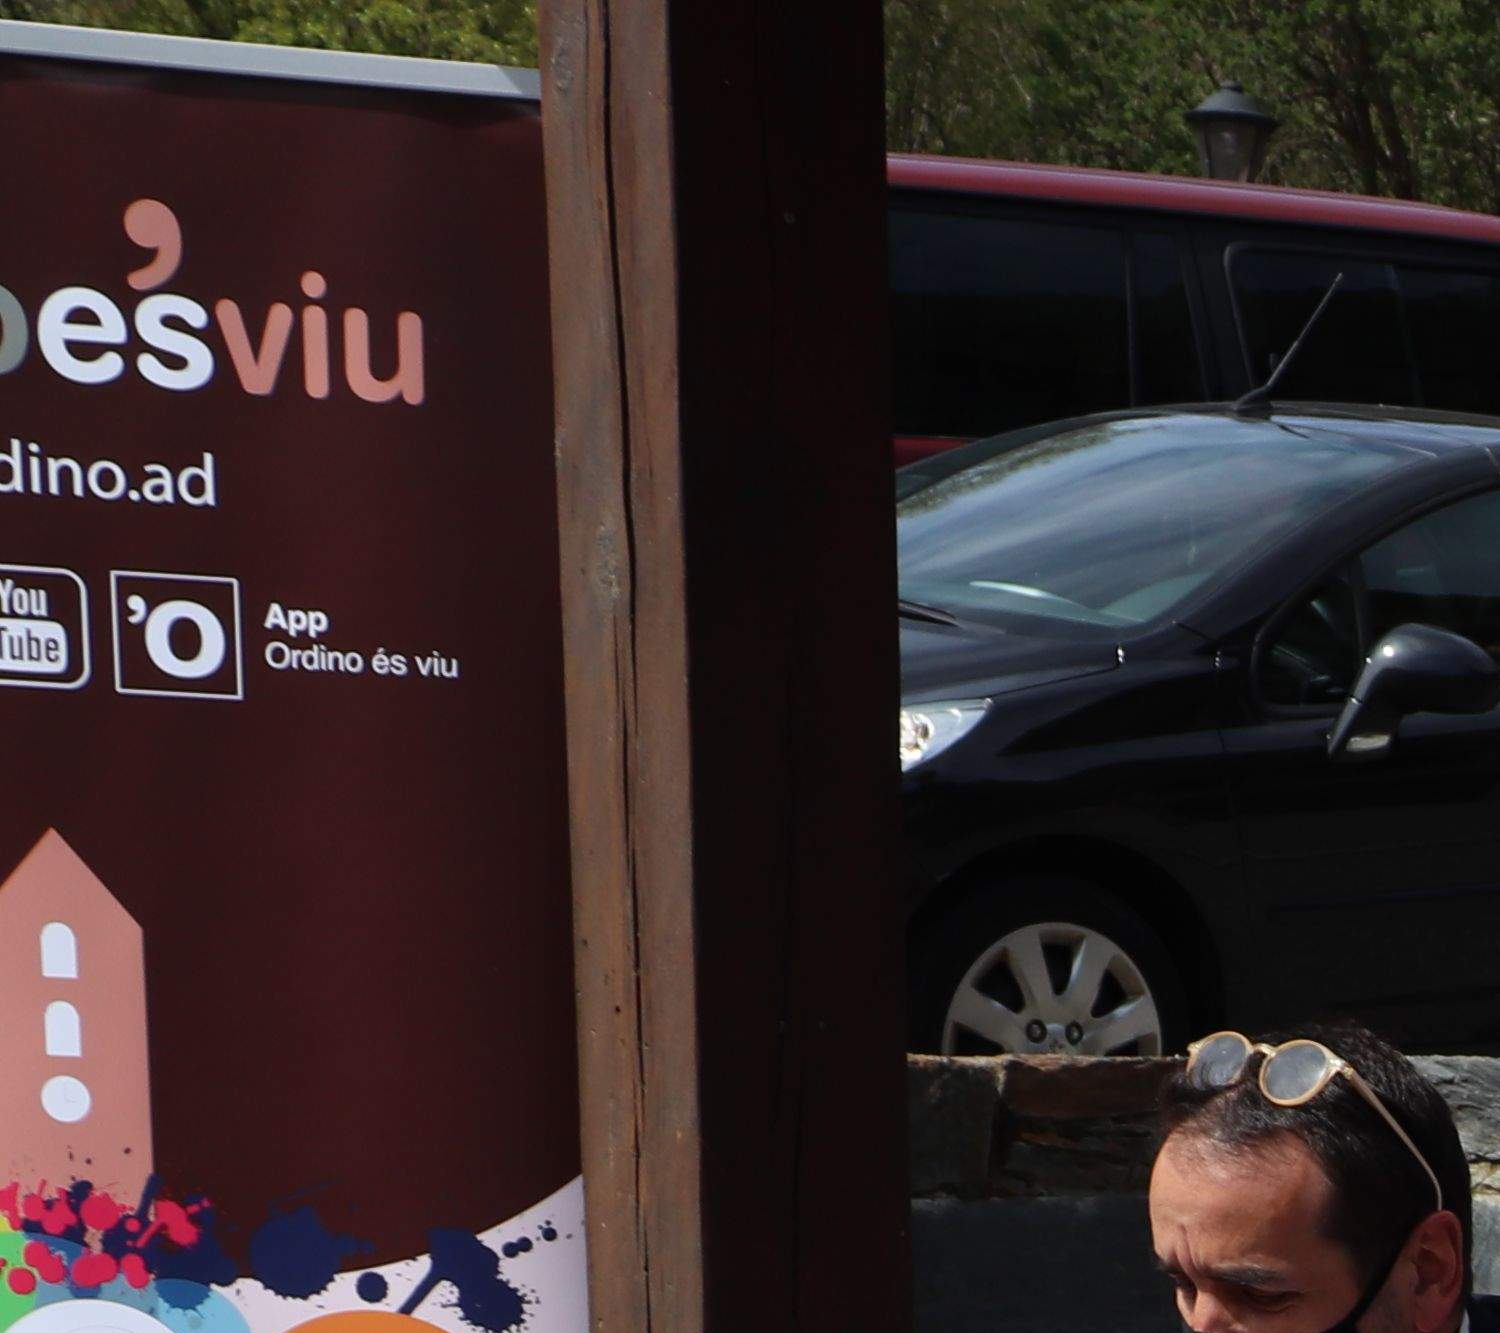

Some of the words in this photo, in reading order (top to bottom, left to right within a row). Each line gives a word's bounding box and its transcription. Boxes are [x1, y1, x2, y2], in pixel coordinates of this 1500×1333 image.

[265, 604, 328, 640] App
[264, 641, 363, 675] Ordino
[372, 647, 407, 676] és
[414, 650, 458, 679] viu
